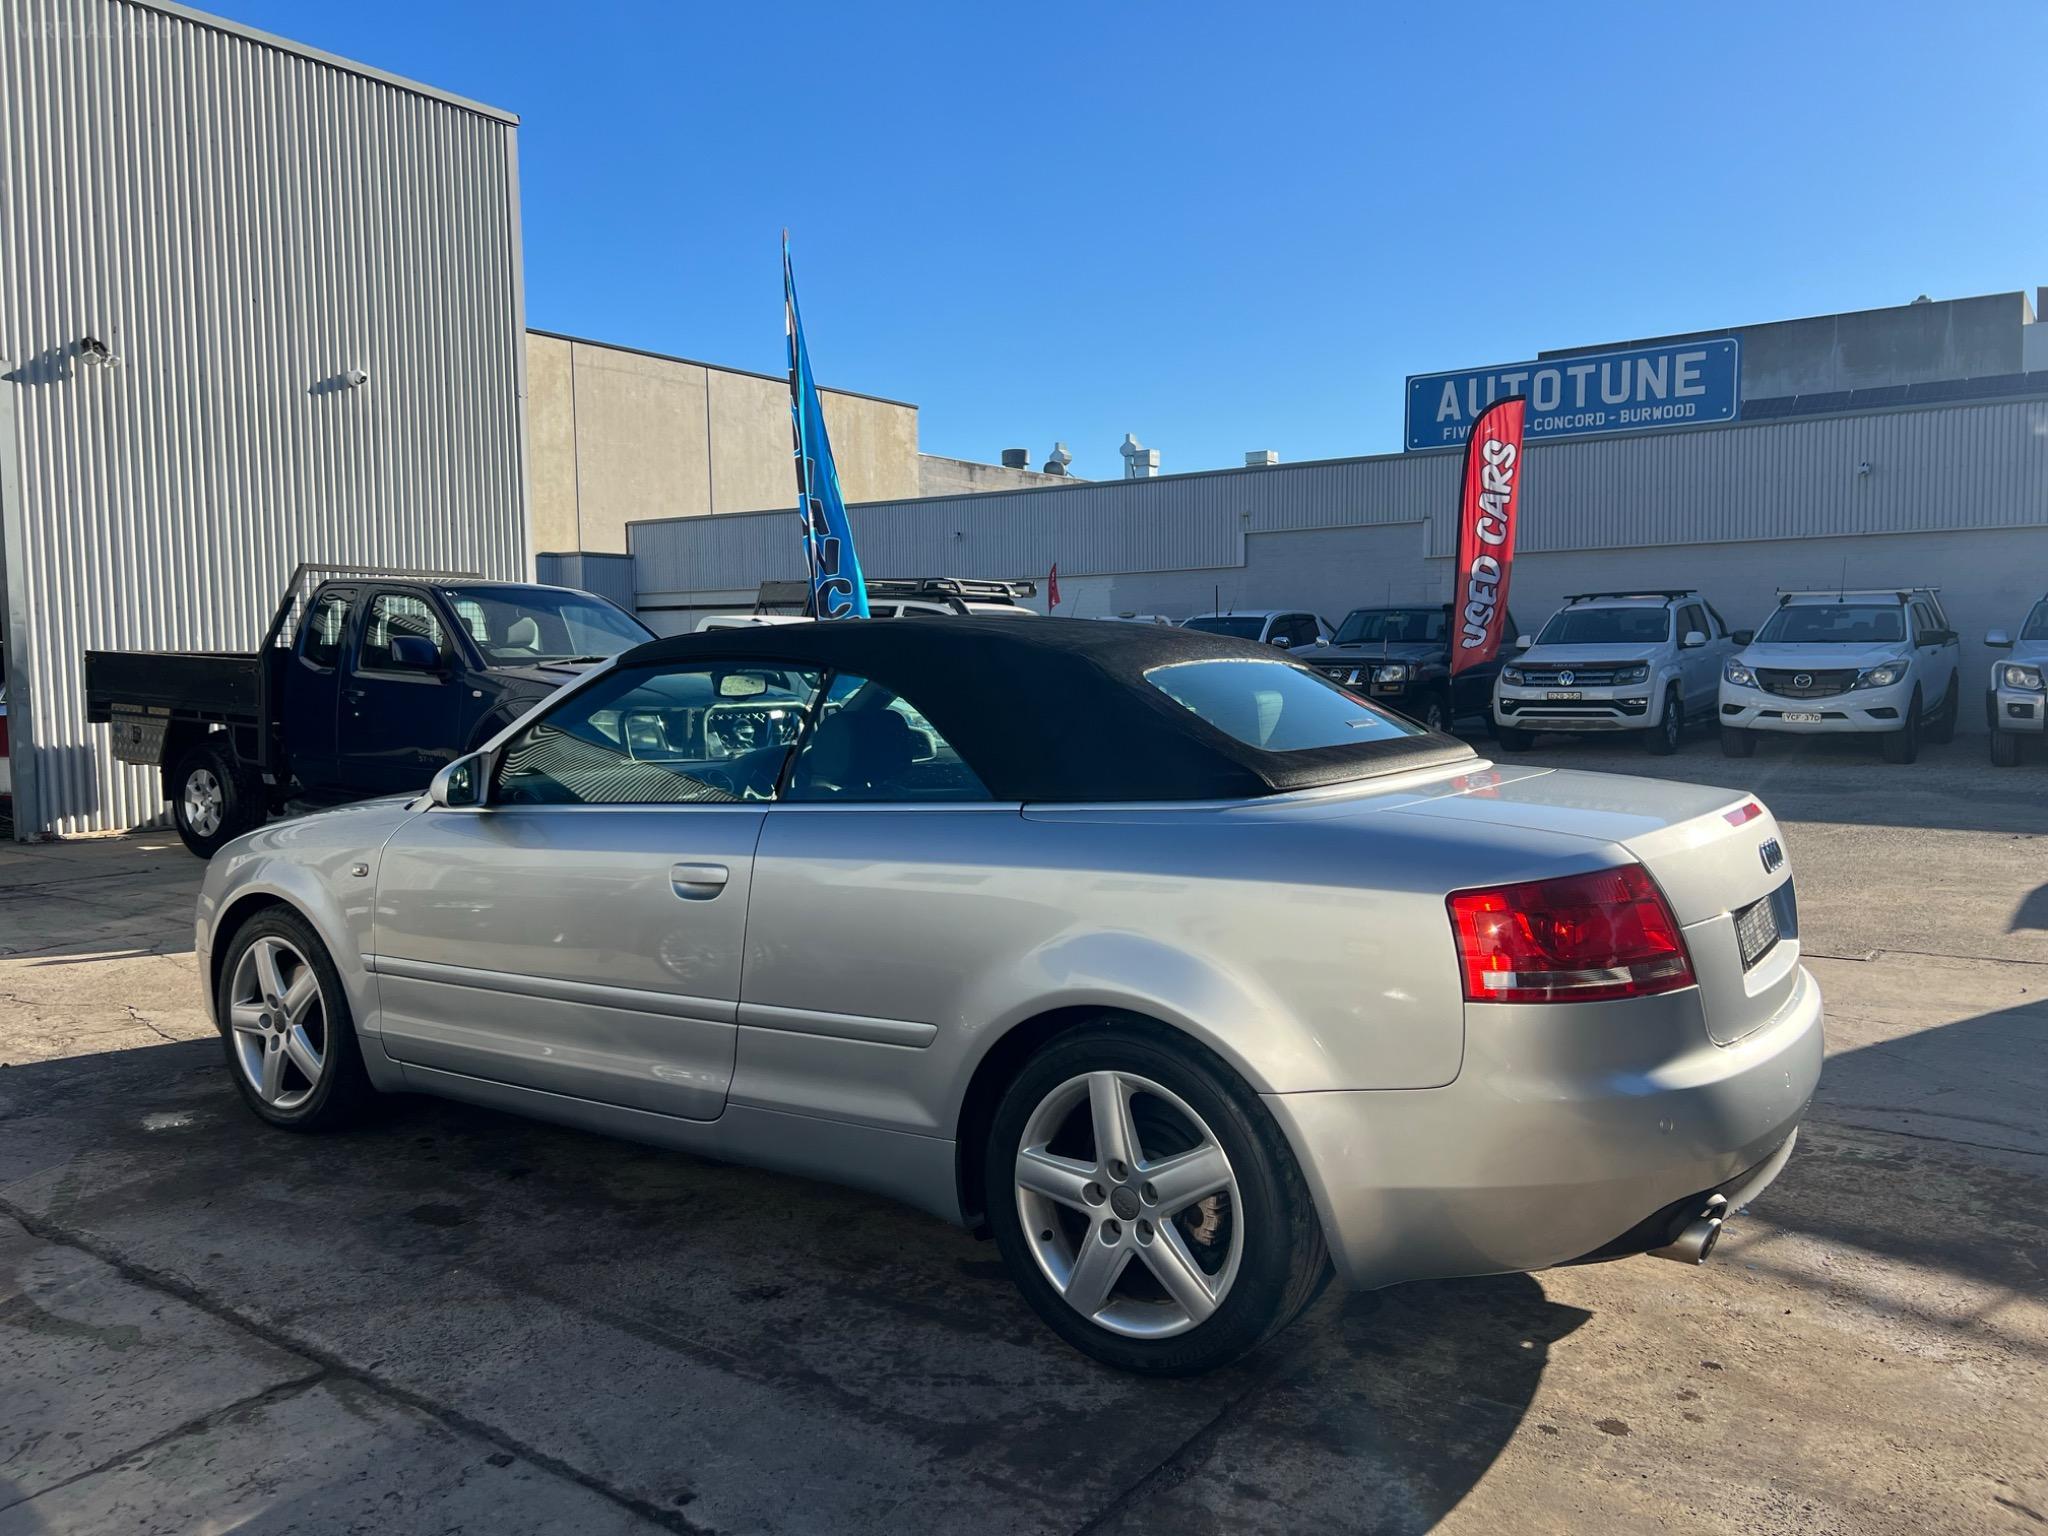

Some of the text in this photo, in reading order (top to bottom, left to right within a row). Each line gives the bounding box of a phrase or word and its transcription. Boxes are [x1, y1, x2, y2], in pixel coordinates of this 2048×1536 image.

[1436, 351, 1707, 422] AUTOTUNE
[1533, 412, 1605, 432] CONCORD
[1619, 402, 1696, 424] BURWOOD
[1461, 438, 1518, 649] USED CARS
